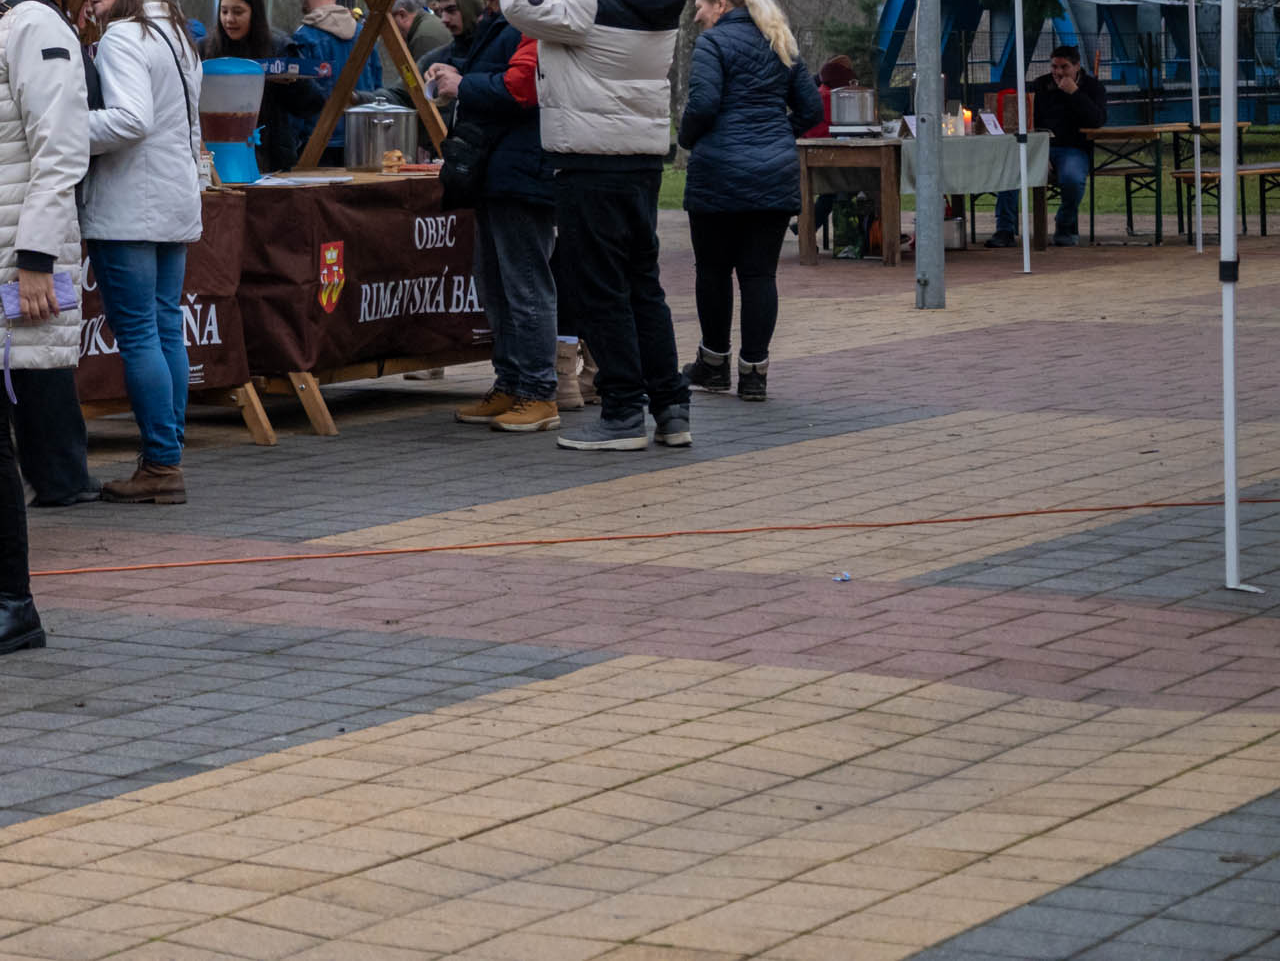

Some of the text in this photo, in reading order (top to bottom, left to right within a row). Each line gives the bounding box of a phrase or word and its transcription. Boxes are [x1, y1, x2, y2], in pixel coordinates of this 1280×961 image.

[414, 215, 457, 250] OBEC
[358, 265, 485, 323] RIMAVSKÁ BA
